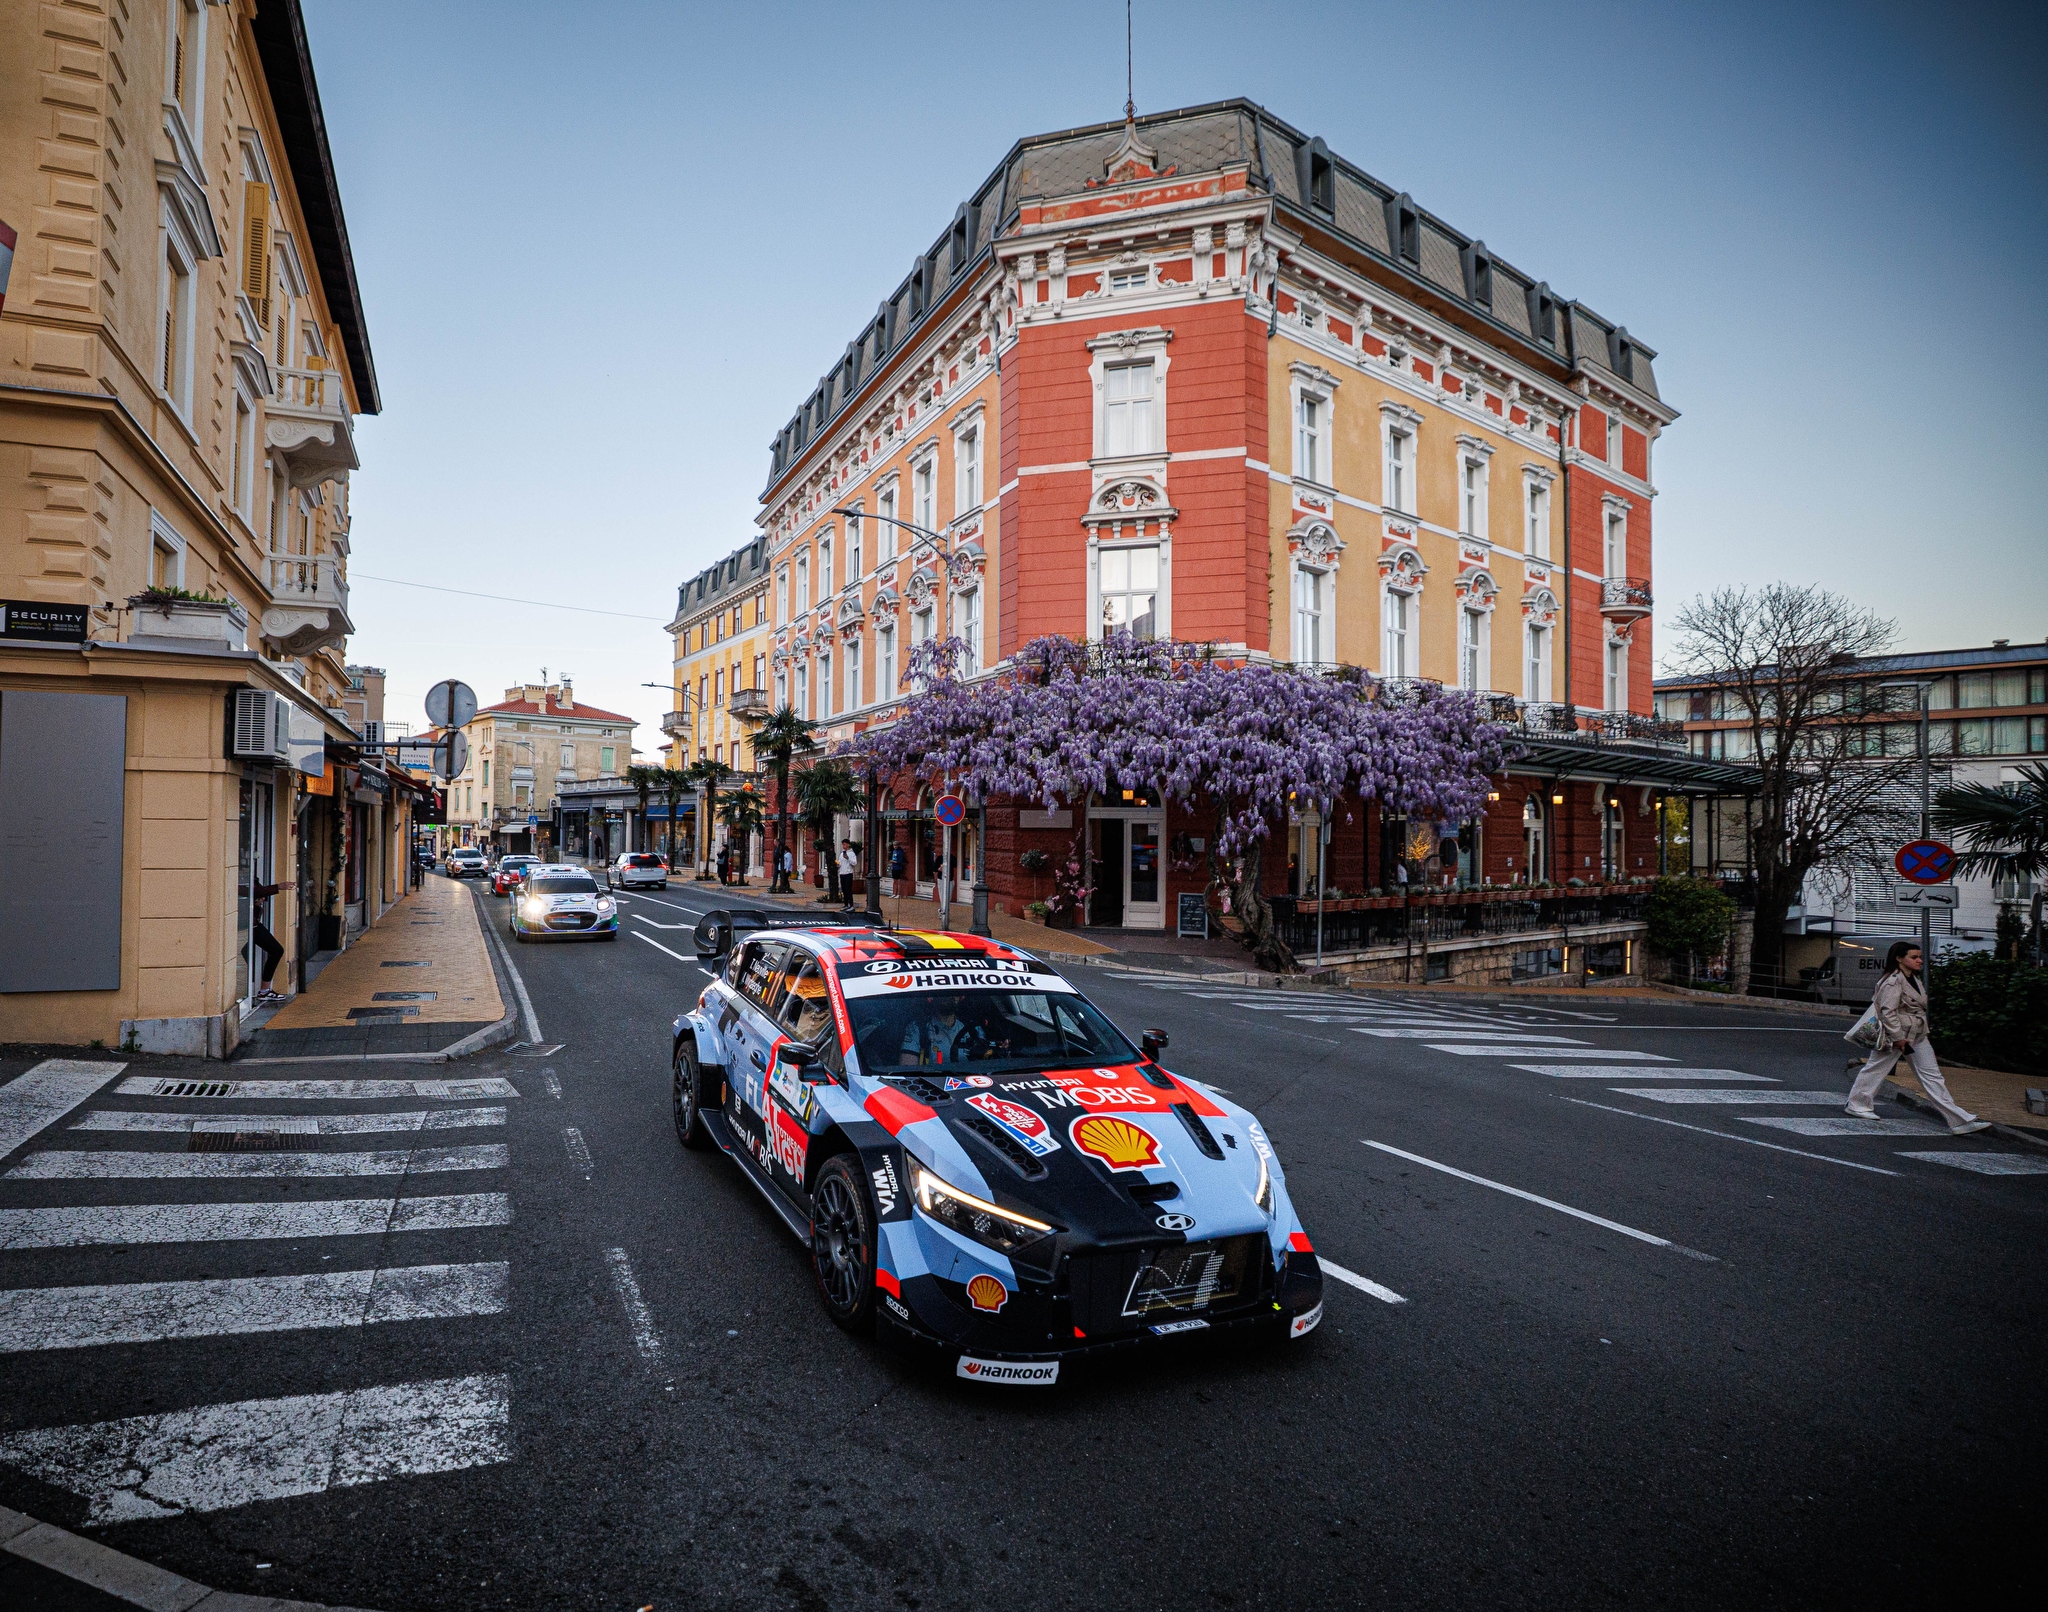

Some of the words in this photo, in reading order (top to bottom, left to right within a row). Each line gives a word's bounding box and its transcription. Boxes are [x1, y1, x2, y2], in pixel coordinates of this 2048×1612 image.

[11, 611, 82, 622] SECURITY
[905, 958, 989, 969] HYUNDAI
[916, 974, 1036, 987] HANKOOK
[1000, 1078, 1085, 1092] HYUNDAI
[1031, 1087, 1157, 1109] MOBIS
[882, 1154, 899, 1192] HYUNDAI
[886, 1295, 909, 1319] sparco
[980, 1365, 1054, 1379] HANKOOK
